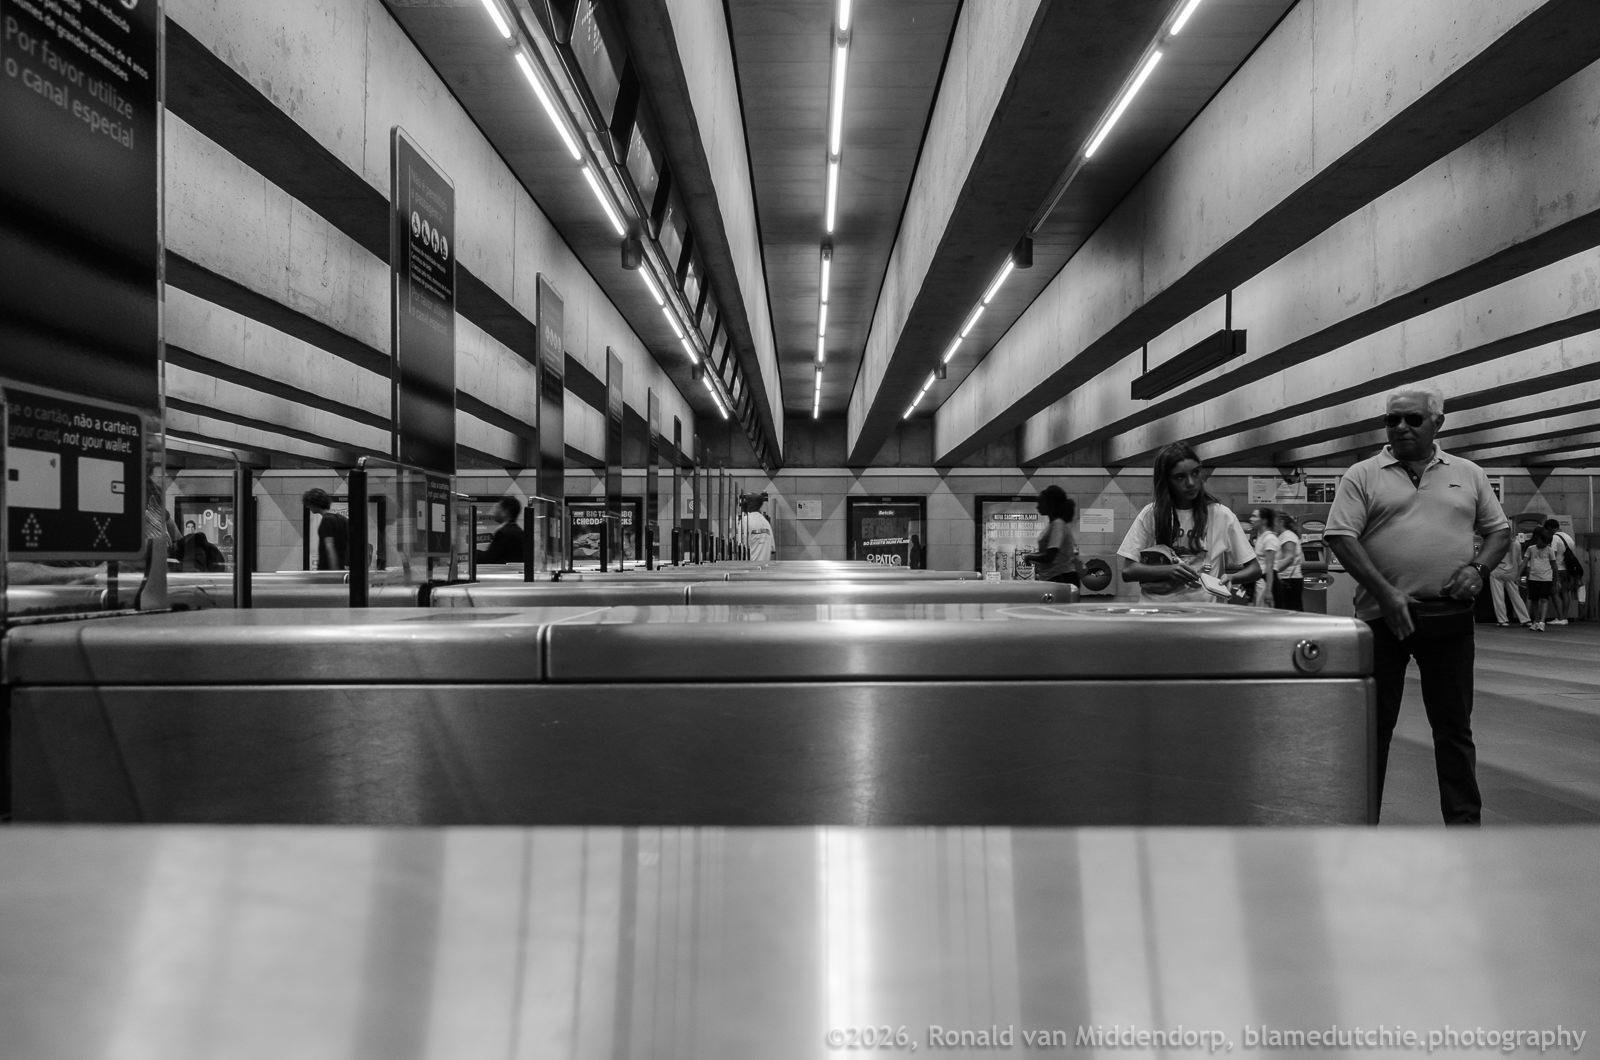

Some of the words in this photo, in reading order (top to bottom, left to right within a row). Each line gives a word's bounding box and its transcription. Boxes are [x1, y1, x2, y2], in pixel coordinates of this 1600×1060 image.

[6, 15, 38, 55] Por
[42, 40, 86, 88] favor
[88, 77, 133, 120] utilize
[5, 57, 18, 78] o
[22, 68, 69, 110] canal
[71, 98, 134, 150] especial
[23, 407, 32, 418] o
[73, 413, 93, 429] não
[94, 418, 101, 429] a
[102, 419, 140, 437] carteira.
[62, 431, 80, 446] not
[82, 436, 103, 451] your
[104, 437, 132, 454] wallet.
